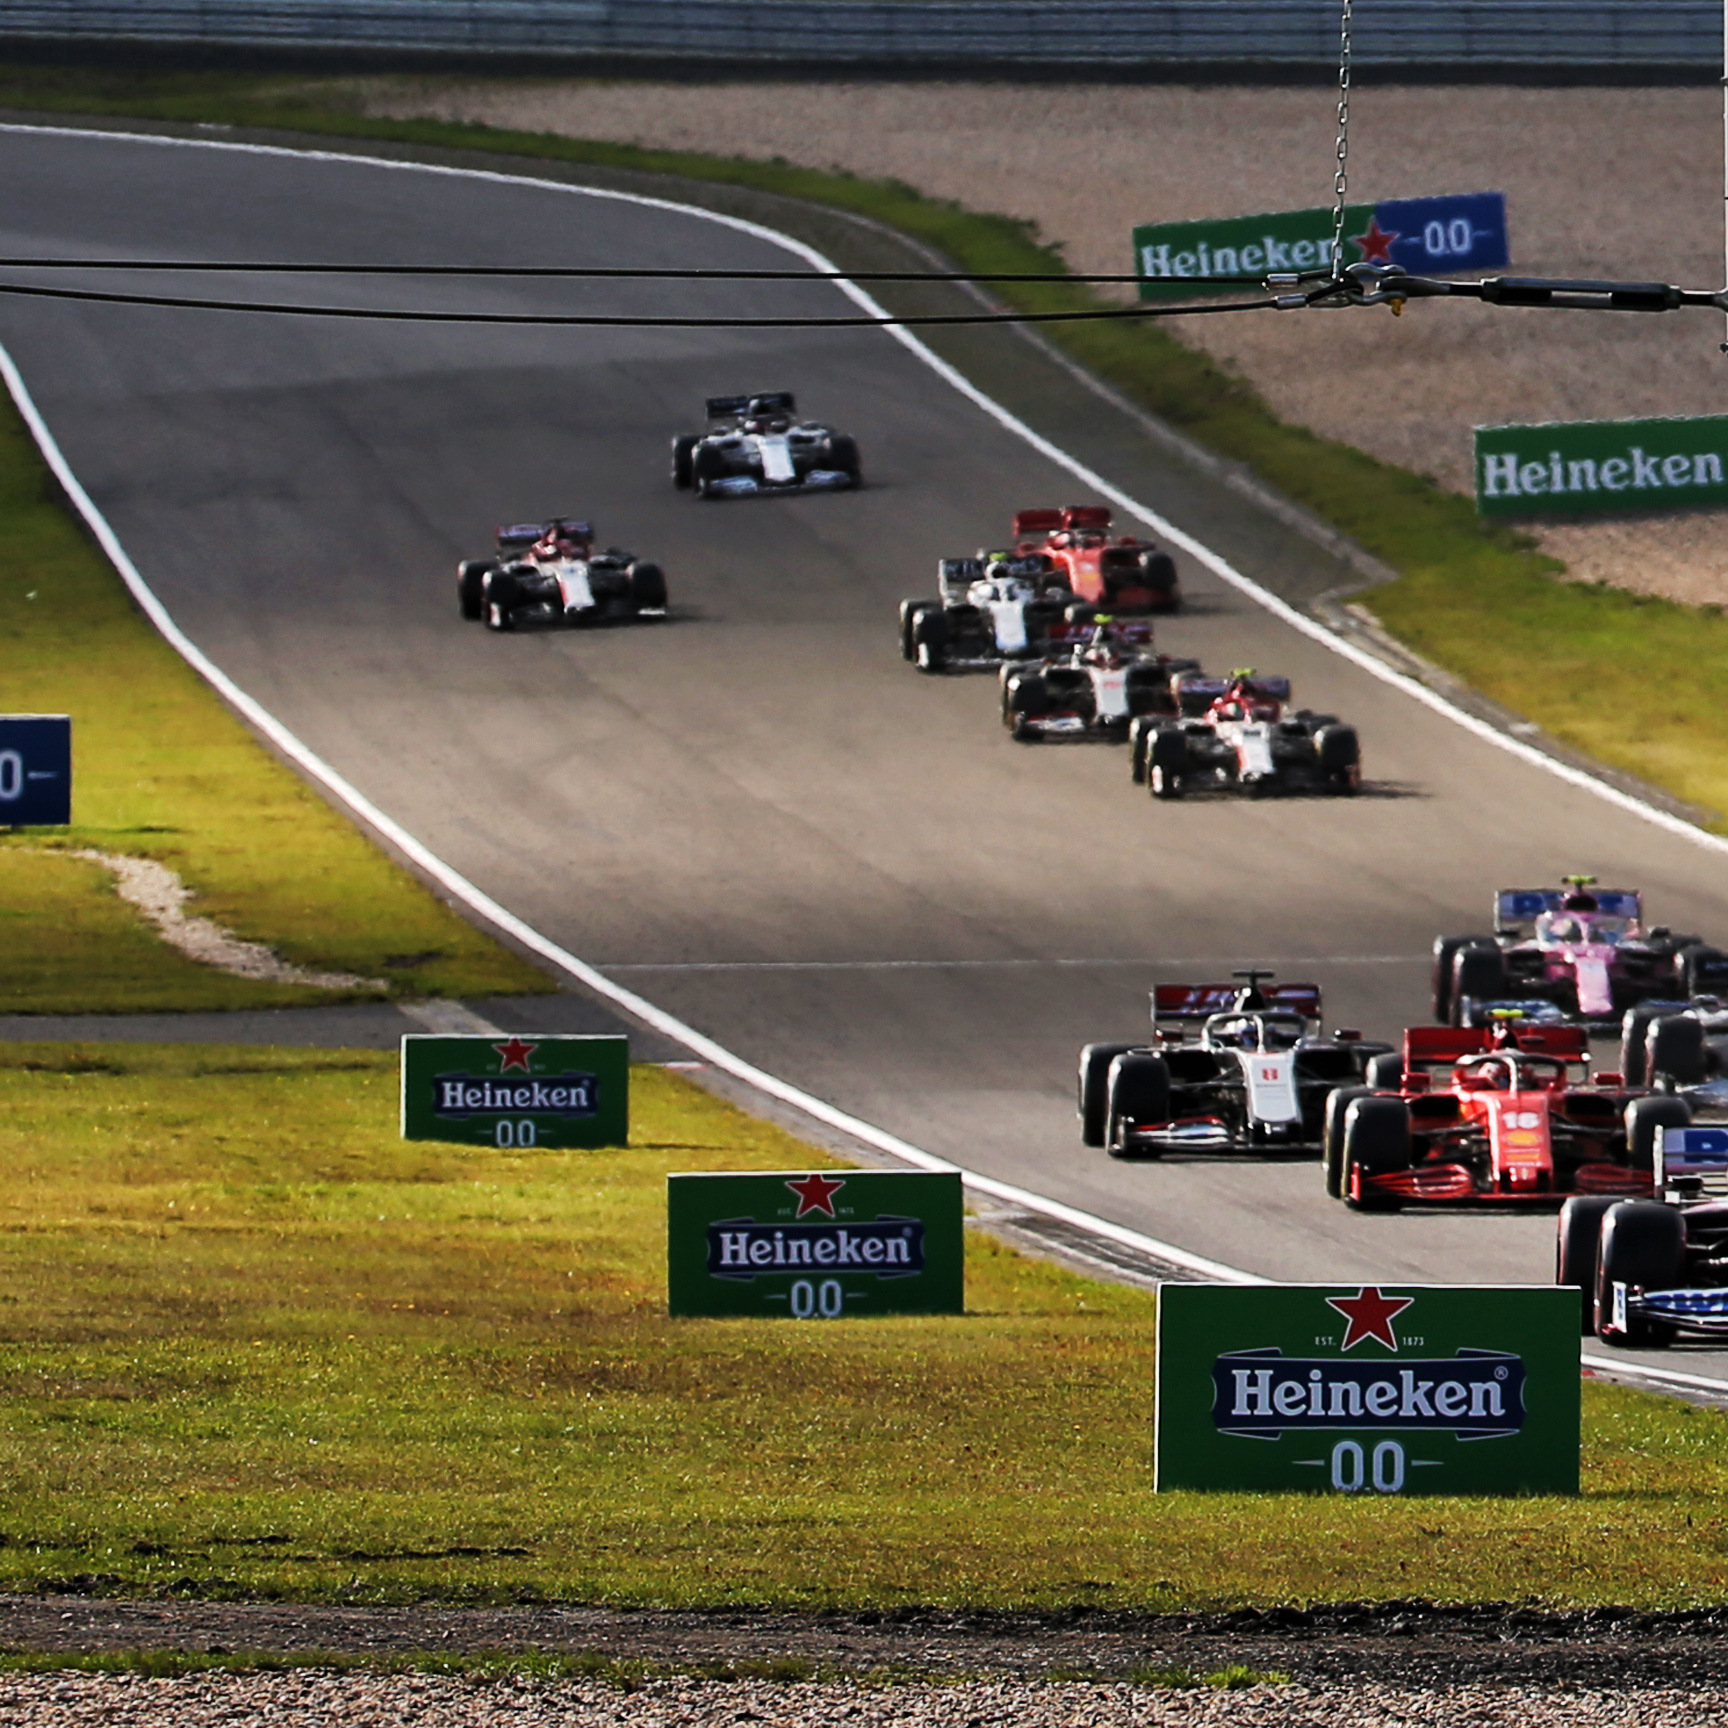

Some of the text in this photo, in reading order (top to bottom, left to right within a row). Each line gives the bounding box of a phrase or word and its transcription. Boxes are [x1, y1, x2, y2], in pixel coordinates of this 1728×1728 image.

[1482, 446, 1723, 498] Heineken
[442, 1081, 588, 1108] Heineken
[719, 1230, 910, 1266] Heineken
[1315, 1336, 1424, 1346] EST. 1873
[1231, 1369, 1506, 1417] Heineken
